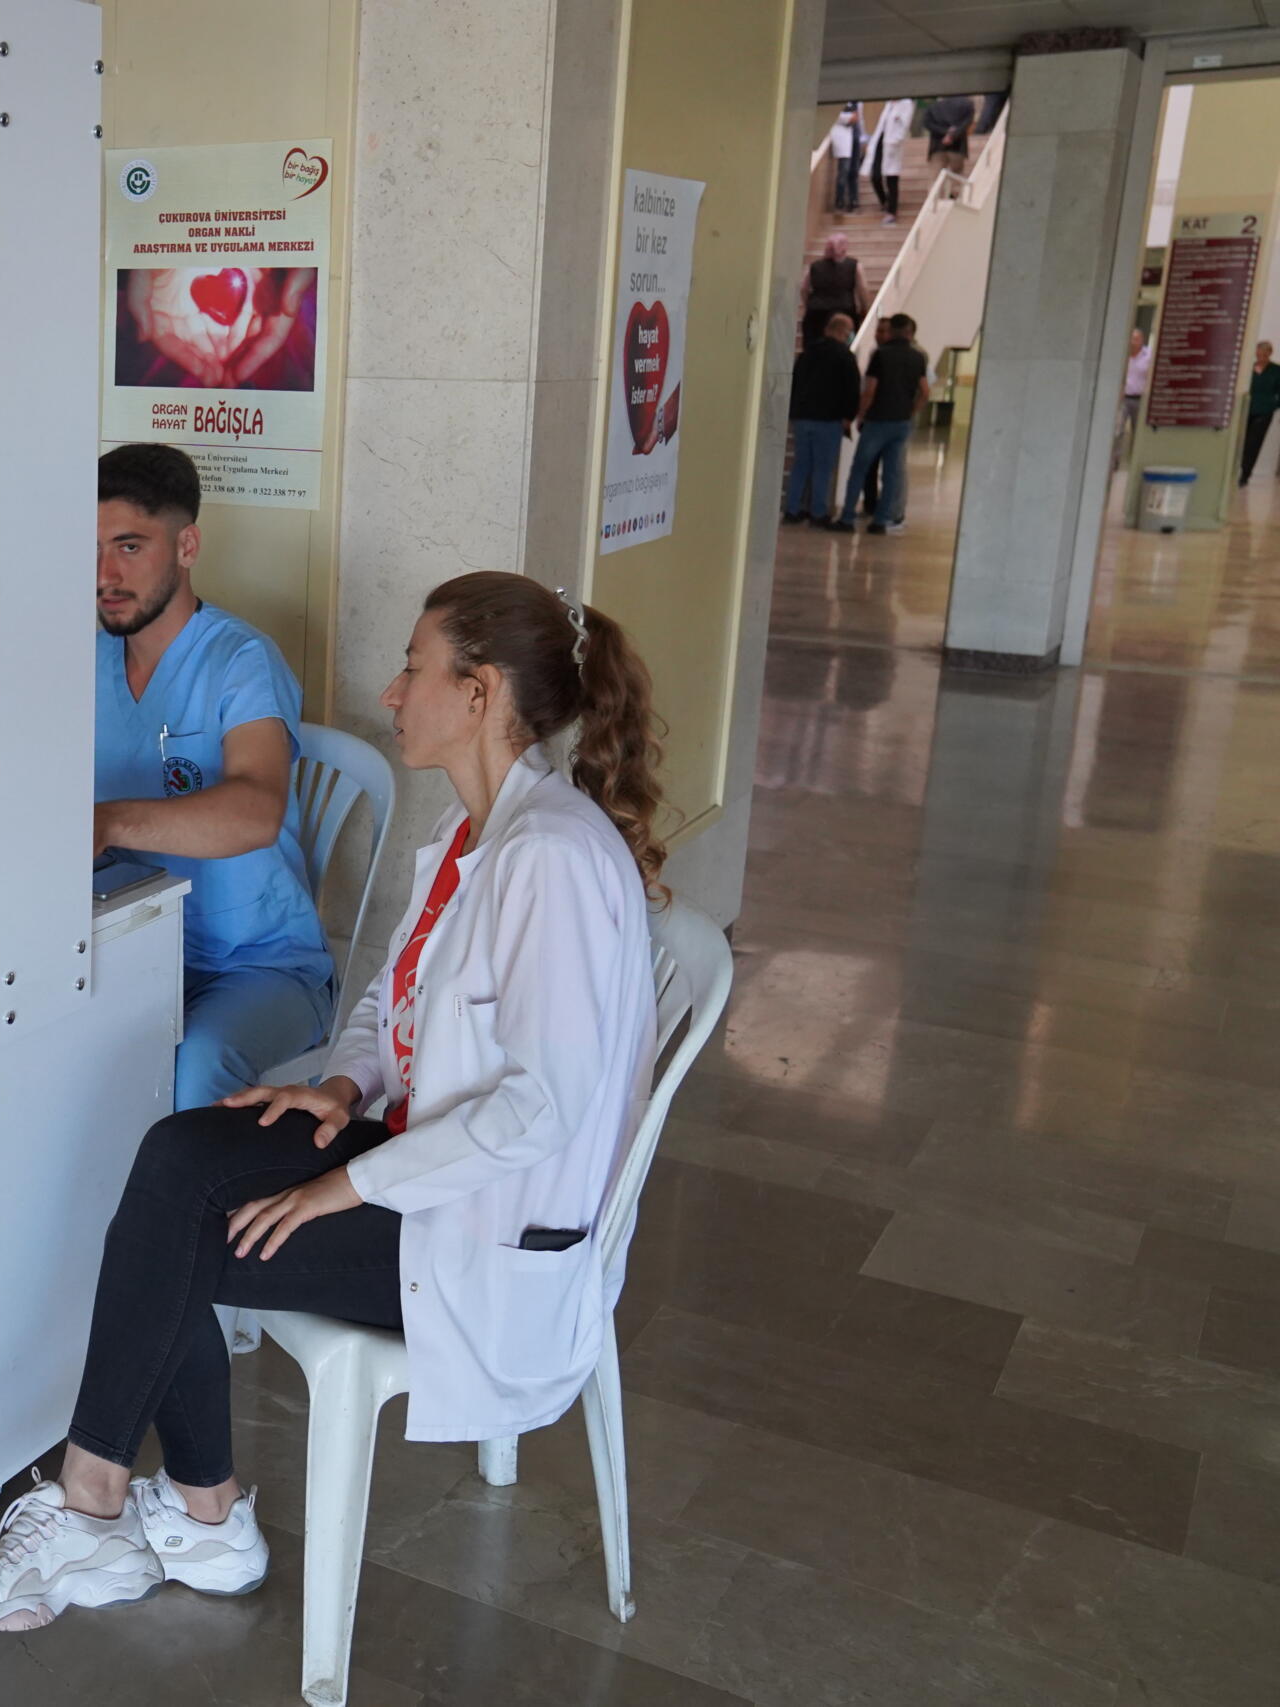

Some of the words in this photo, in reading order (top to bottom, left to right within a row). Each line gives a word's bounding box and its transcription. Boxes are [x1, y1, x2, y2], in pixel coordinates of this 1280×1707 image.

[287, 161, 299, 169] bir
[284, 170, 296, 179] bir
[633, 185, 676, 217] kalbinize
[158, 212, 212, 224] ÇUKUROVA
[214, 207, 287, 222] ÜNİVERSİTESİ
[188, 227, 221, 238] ORGAN
[224, 224, 256, 237] NAKLİ
[1181, 216, 1210, 230] KAT
[1241, 215, 1258, 235] 2
[133, 243, 192, 254] ARAŞTIRMA
[195, 243, 208, 253] VE
[210, 242, 265, 253] UYGULAMA
[268, 239, 315, 252] MERKEZİ
[635, 227, 650, 254] bir
[651, 228, 668, 255] kez
[630, 272, 666, 293] sorun...
[638, 325, 660, 349] hayat
[634, 354, 661, 374] vermek
[630, 387, 646, 405] ister
[646, 383, 659, 403] mi?
[152, 403, 188, 416] ORGAN
[152, 418, 188, 430] HAYAT
[194, 400, 264, 442] BAĞIŞLA
[208, 452, 248, 464] Üniversitesi
[223, 464, 259, 475] Uygulama
[260, 466, 289, 476] Merkezi
[259, 488, 272, 496] 322
[272, 488, 287, 497] 338
